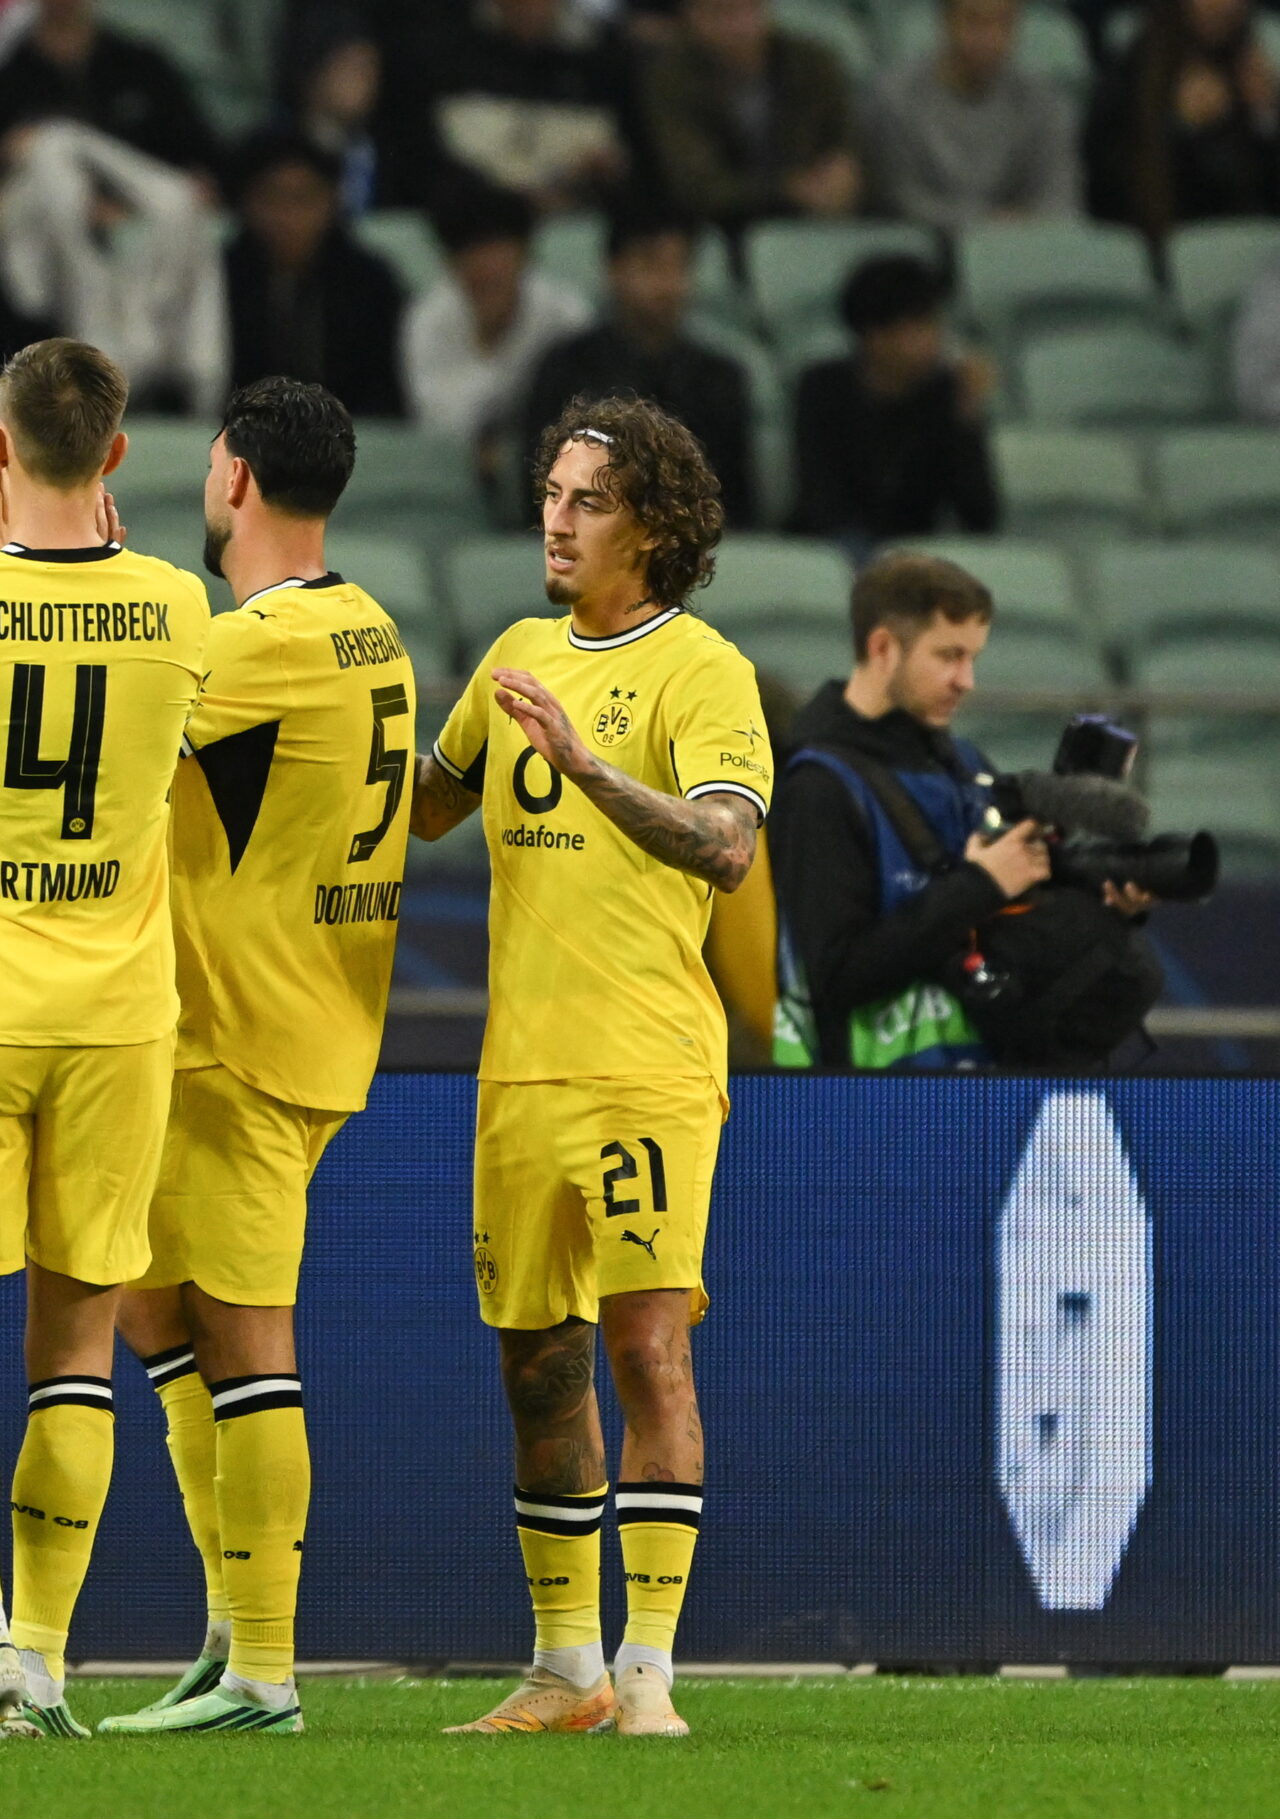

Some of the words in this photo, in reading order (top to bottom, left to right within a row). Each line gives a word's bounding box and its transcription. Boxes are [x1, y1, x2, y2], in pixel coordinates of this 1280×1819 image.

[596, 706, 630, 735] BVB
[3, 663, 108, 840] 4
[346, 683, 408, 865] 5
[501, 823, 585, 851] vodafone
[600, 1137, 668, 1218] 21
[53, 1516, 90, 1530] 09
[222, 1550, 252, 1561] 09
[656, 1575, 683, 1585] 09
